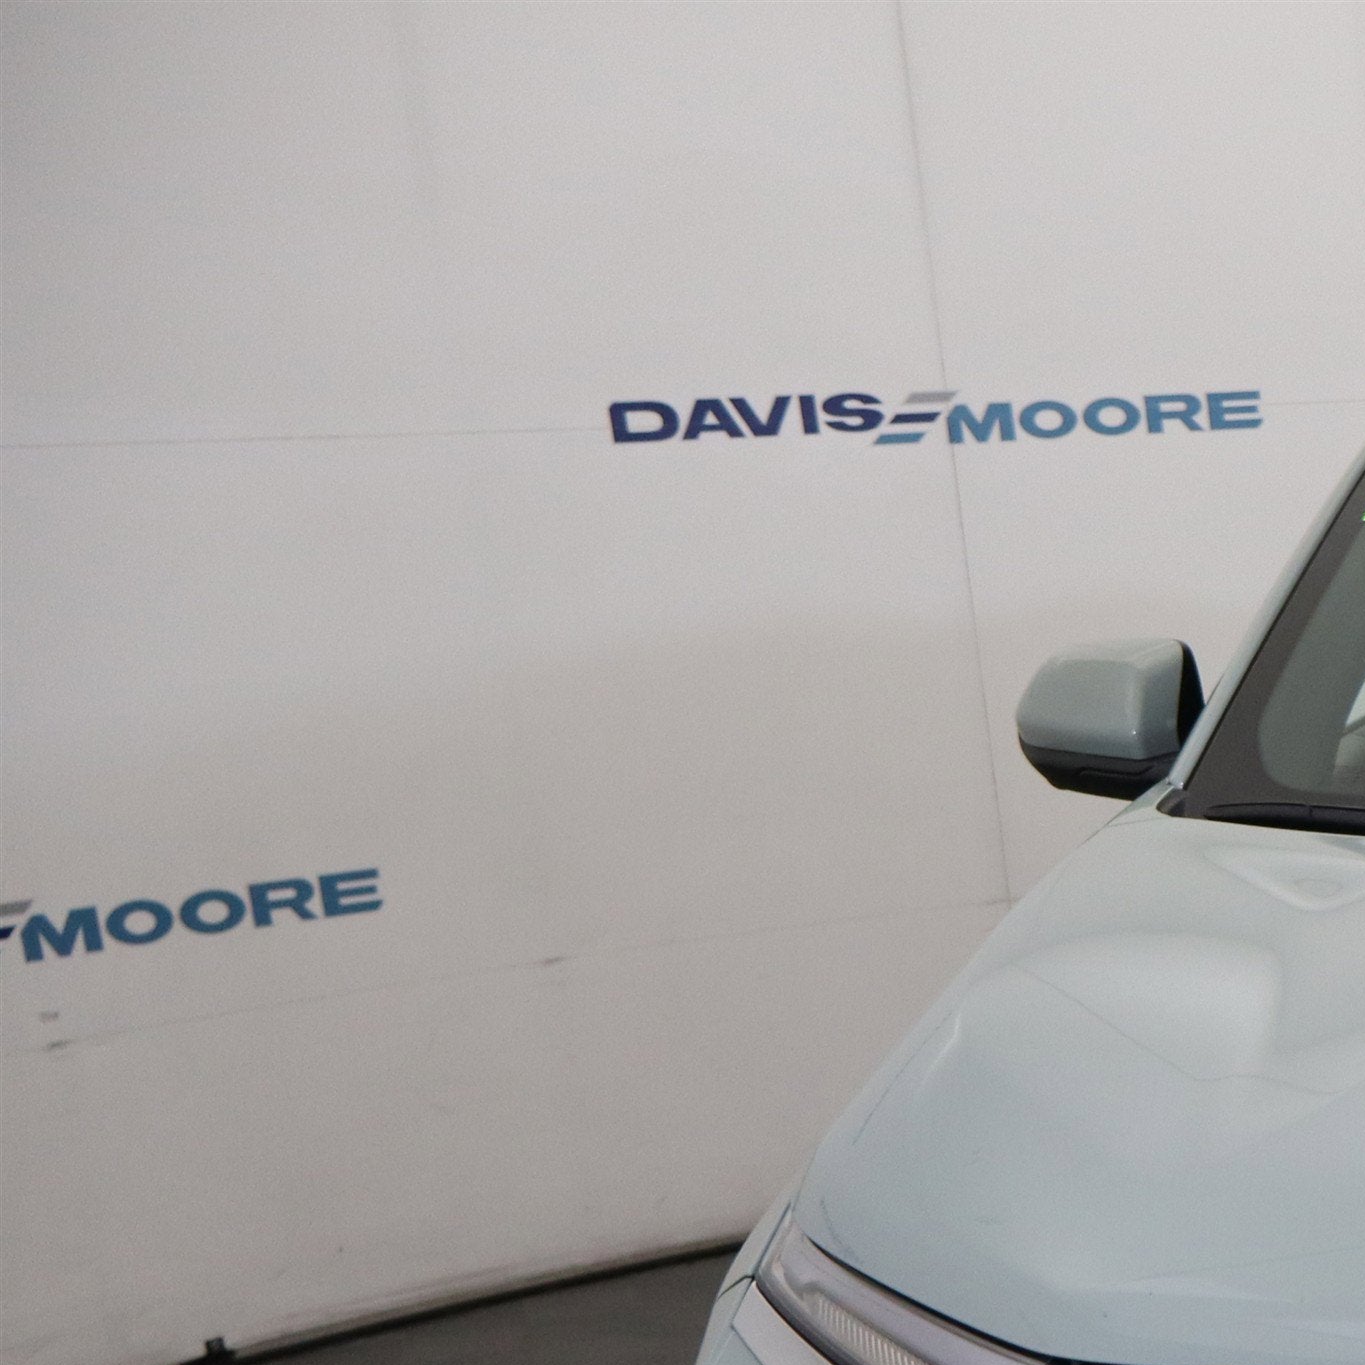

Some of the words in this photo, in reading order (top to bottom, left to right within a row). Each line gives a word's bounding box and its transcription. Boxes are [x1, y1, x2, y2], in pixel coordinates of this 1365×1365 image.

[607, 391, 886, 444] DAVIS
[946, 389, 1265, 445] MOORE
[19, 867, 384, 963] MOORE
